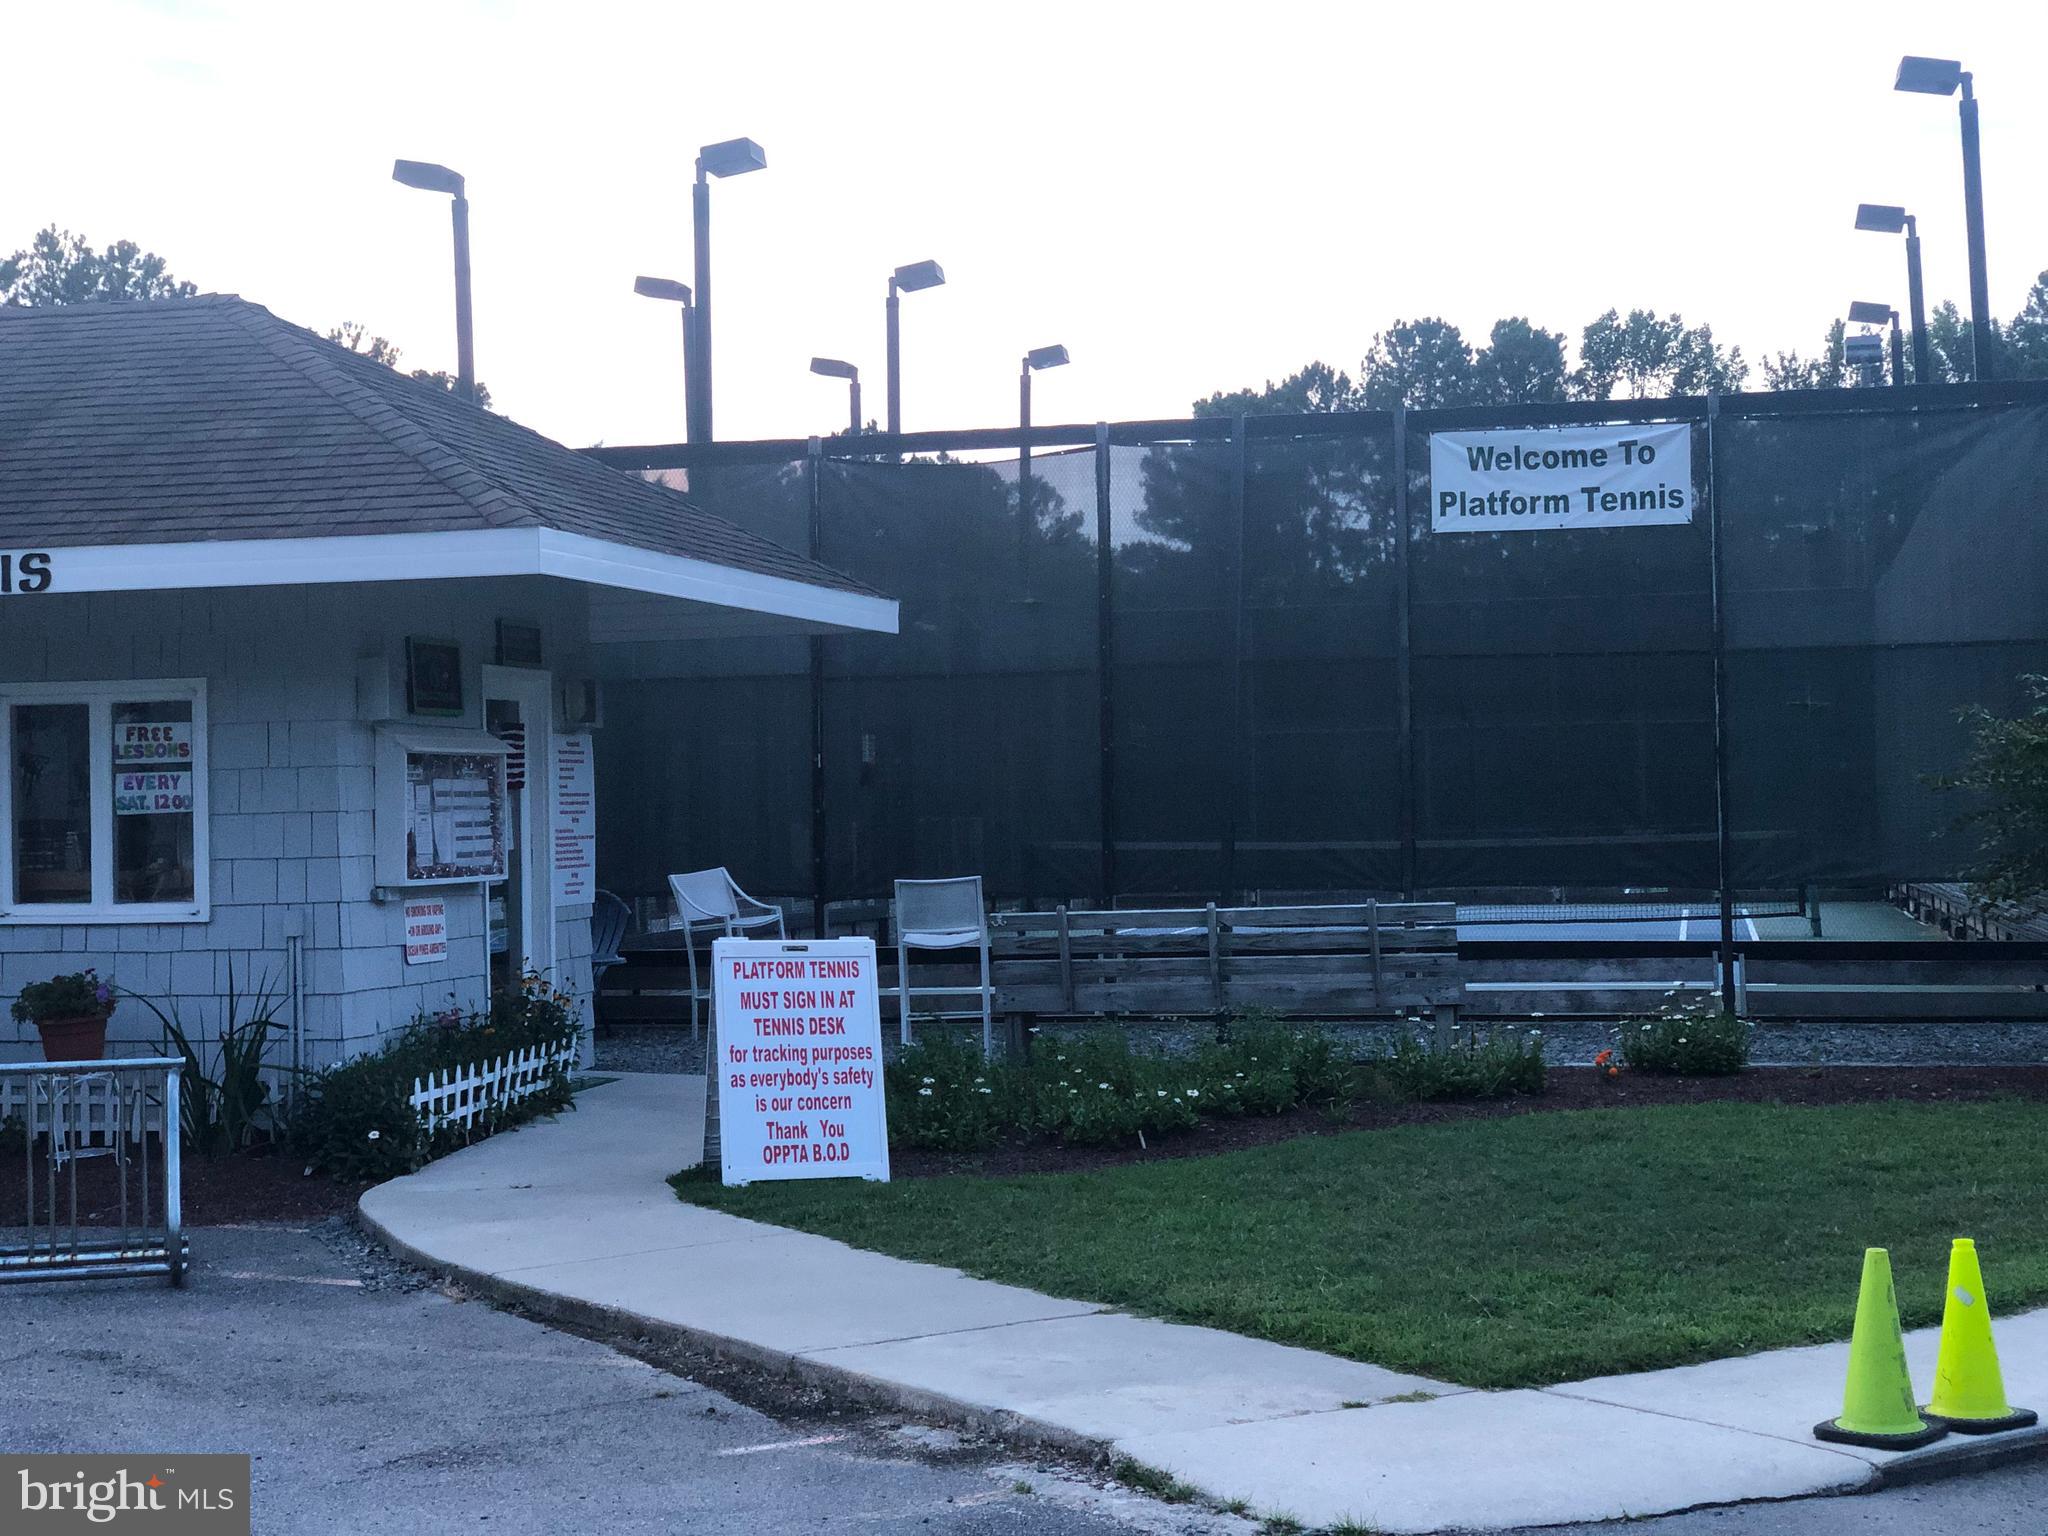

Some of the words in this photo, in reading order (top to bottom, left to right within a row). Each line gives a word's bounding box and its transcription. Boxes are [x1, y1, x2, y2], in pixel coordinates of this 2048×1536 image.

[1467, 444, 1608, 472] Welcome
[1618, 439, 1656, 465] To
[1439, 489, 1570, 517] Platform
[1580, 483, 1685, 513] Tennis
[0, 553, 52, 593] IS
[126, 727, 173, 741] FREE
[112, 742, 190, 759] LESSONS
[123, 774, 181, 791] EVERY
[733, 961, 805, 979] PLATFORM
[809, 961, 860, 978] TENNIS
[740, 992, 779, 1010] MUST
[783, 991, 816, 1009] SIGN
[821, 991, 835, 1008] IN
[839, 990, 855, 1008] AT
[753, 1018, 805, 1036] TENNIS
[809, 1017, 846, 1035] DESK
[729, 1045, 748, 1063] for
[753, 1044, 808, 1066] tracking
[812, 1044, 873, 1065] purposes
[730, 1072, 746, 1088] as
[750, 1067, 829, 1091] everybody's
[833, 1066, 874, 1089] safety
[755, 1094, 767, 1112] is
[771, 1096, 793, 1111] our
[797, 1094, 852, 1111] concern
[766, 1121, 808, 1140] Thank
[820, 1119, 845, 1138] You
[763, 1145, 809, 1164] OPPTA
[813, 1143, 850, 1162] B.O.D
